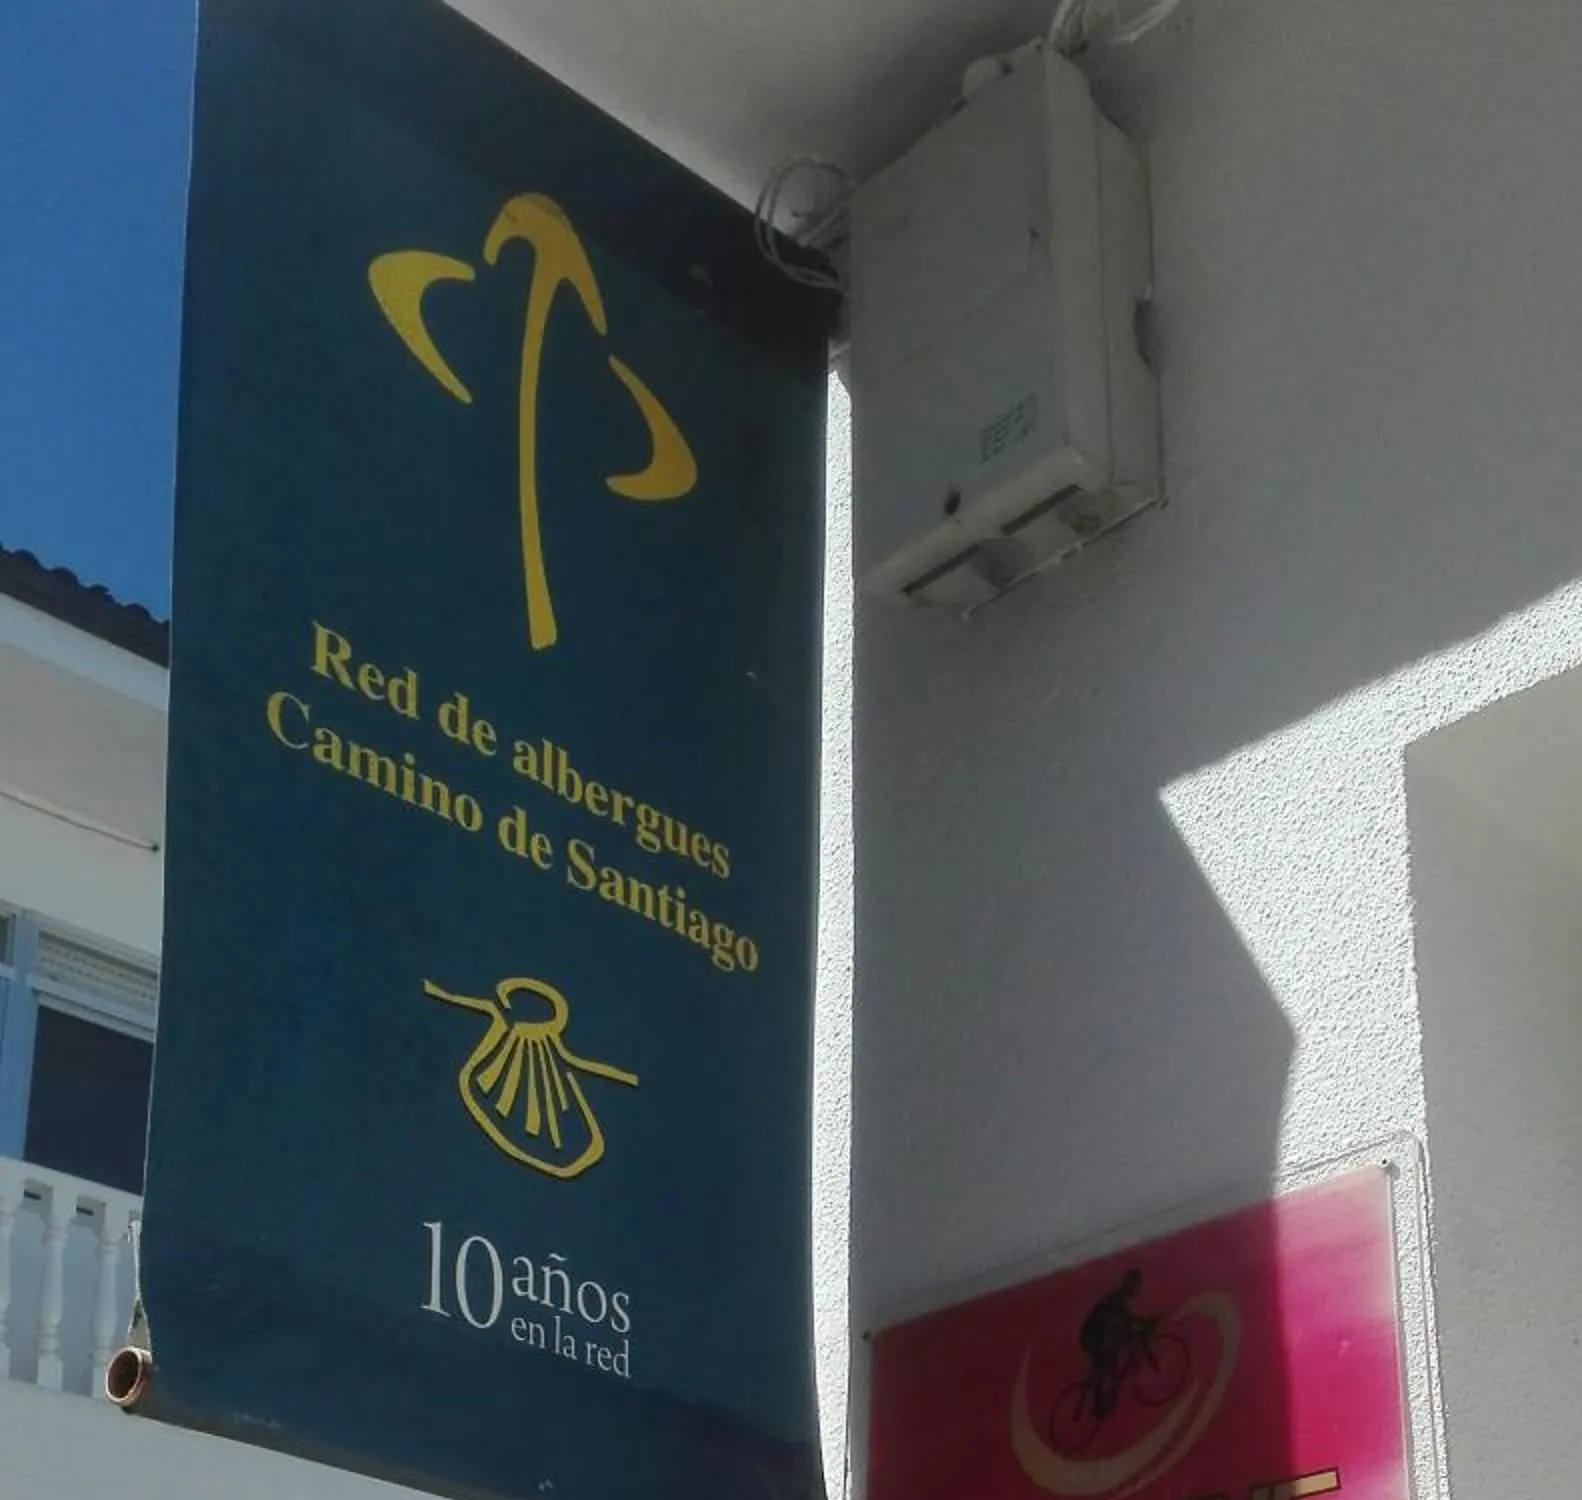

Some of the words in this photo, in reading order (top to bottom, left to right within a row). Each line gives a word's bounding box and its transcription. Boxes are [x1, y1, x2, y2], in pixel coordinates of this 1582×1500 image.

[266, 690, 484, 833] Camino
[499, 805, 554, 870] de
[566, 838, 760, 973] Santiago
[310, 620, 421, 721] Red
[437, 692, 498, 757] de
[512, 737, 731, 880] albergues
[420, 1221, 504, 1329] 10
[511, 1252, 631, 1333] años
[511, 1316, 546, 1349] en
[554, 1315, 577, 1360] la
[585, 1339, 632, 1379] red
